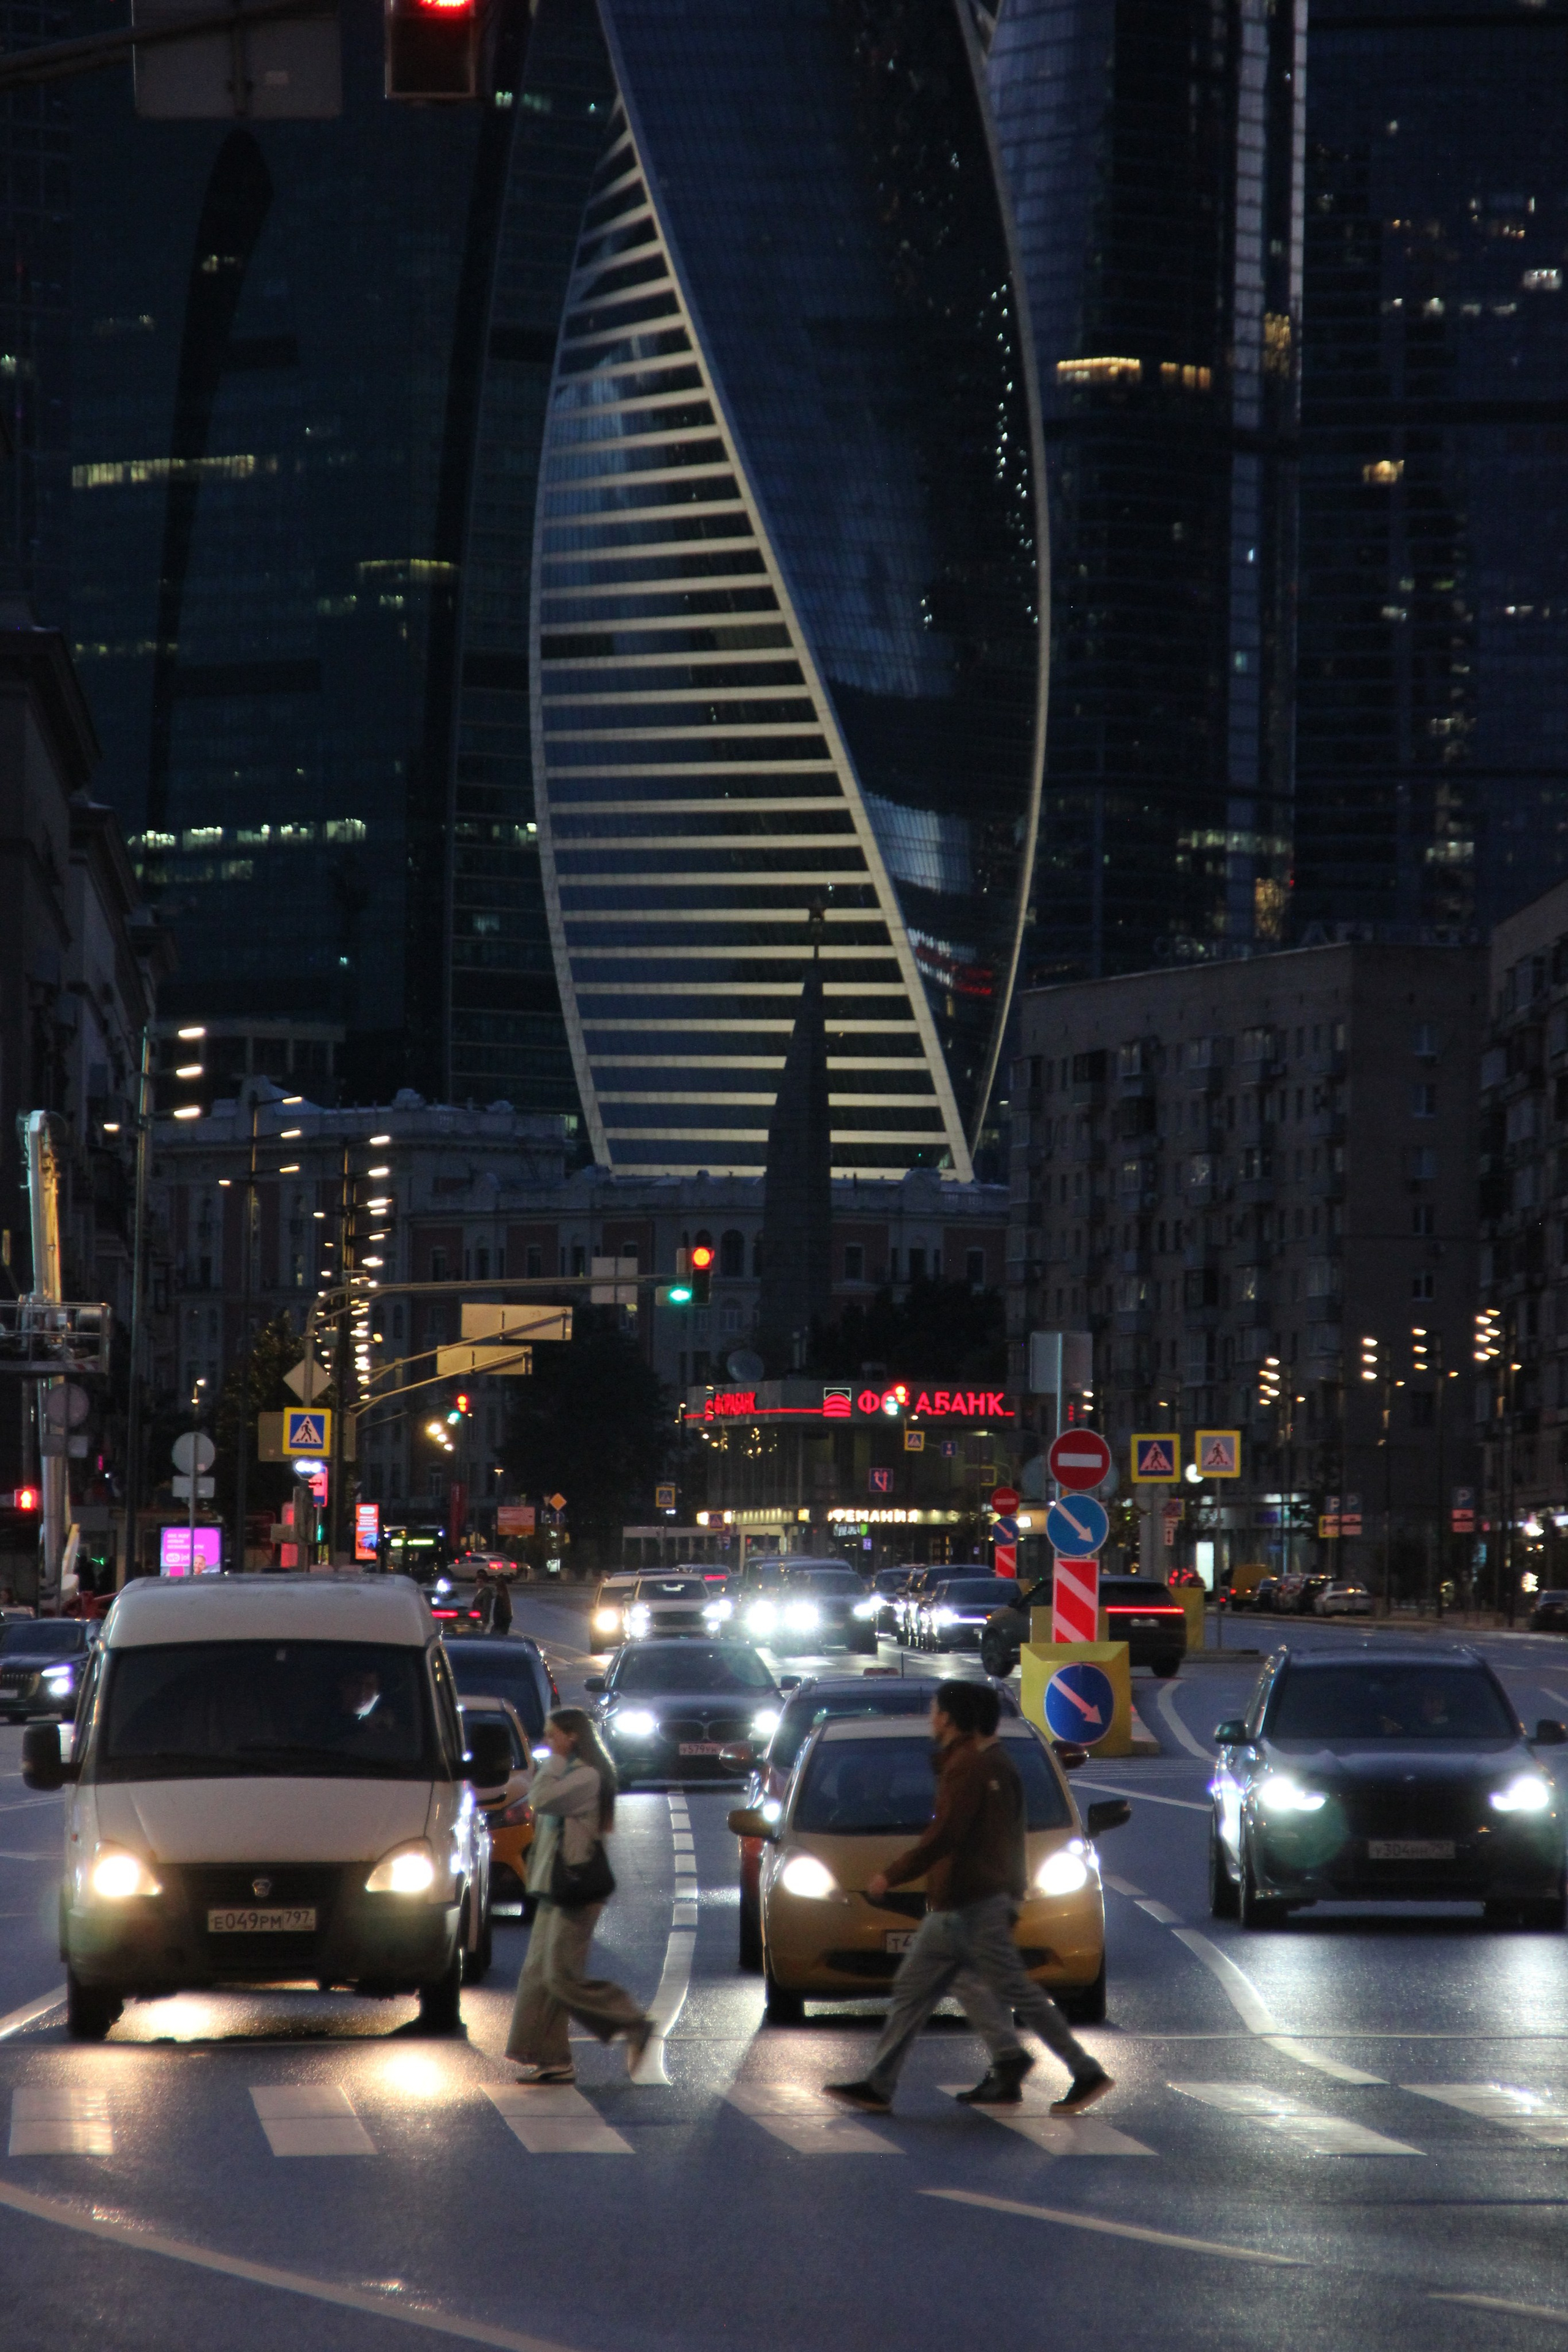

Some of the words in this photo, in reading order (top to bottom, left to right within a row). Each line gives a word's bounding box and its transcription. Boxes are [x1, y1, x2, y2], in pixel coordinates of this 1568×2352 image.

[858, 1389, 1005, 1416] ФАБАНК
[214, 1912, 282, 1929] Е049РМ
[285, 1911, 309, 1924] 797
